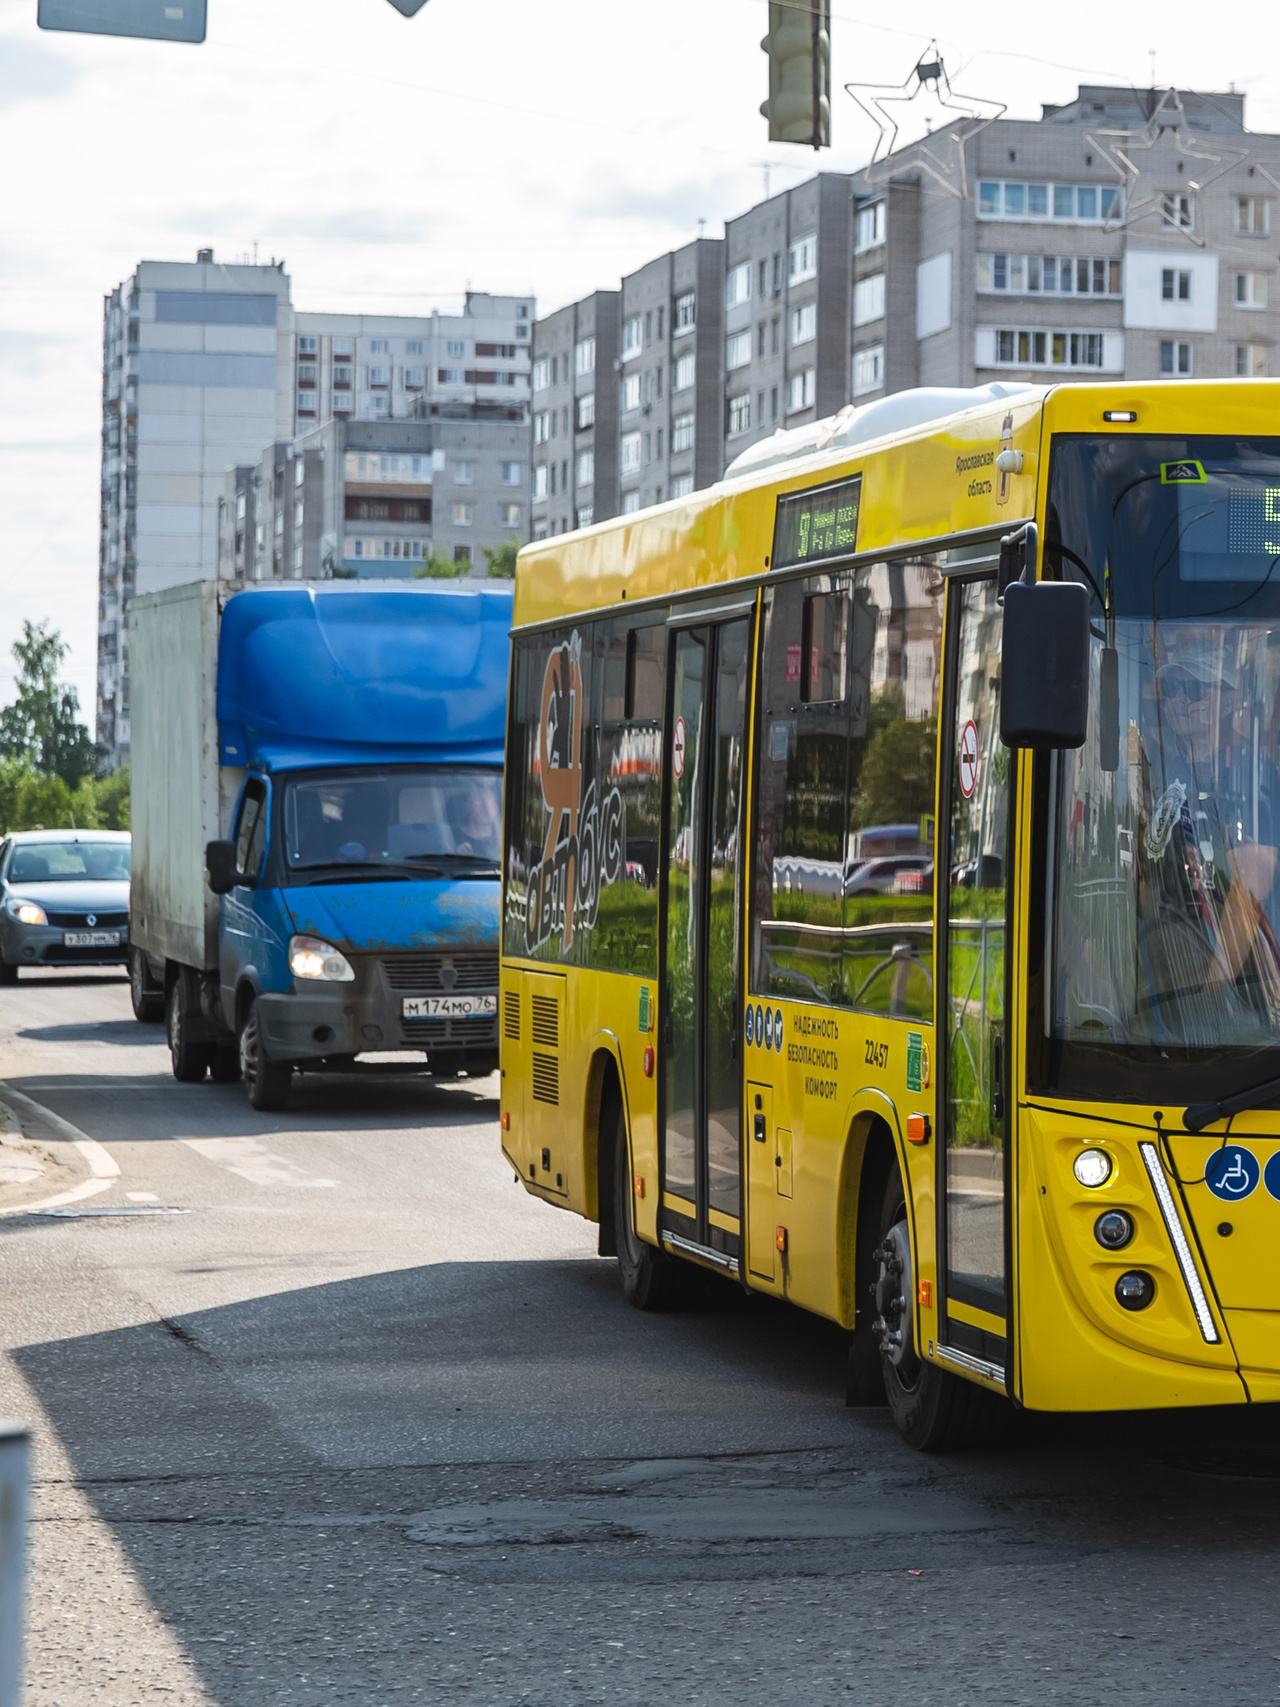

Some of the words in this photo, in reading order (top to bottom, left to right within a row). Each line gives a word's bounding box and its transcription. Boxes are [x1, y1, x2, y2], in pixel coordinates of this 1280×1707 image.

[955, 451, 994, 476] Ярославская
[967, 478, 992, 497] область
[408, 999, 472, 1015] М174МО
[477, 997, 492, 1009] 76
[793, 1015, 839, 1040] НАДЕЖНОСТЬ
[787, 1043, 839, 1070] БЕЗОПАСНОСТЬ
[864, 1039, 889, 1069] 22457
[804, 1076, 838, 1101] КОМФОРТ
